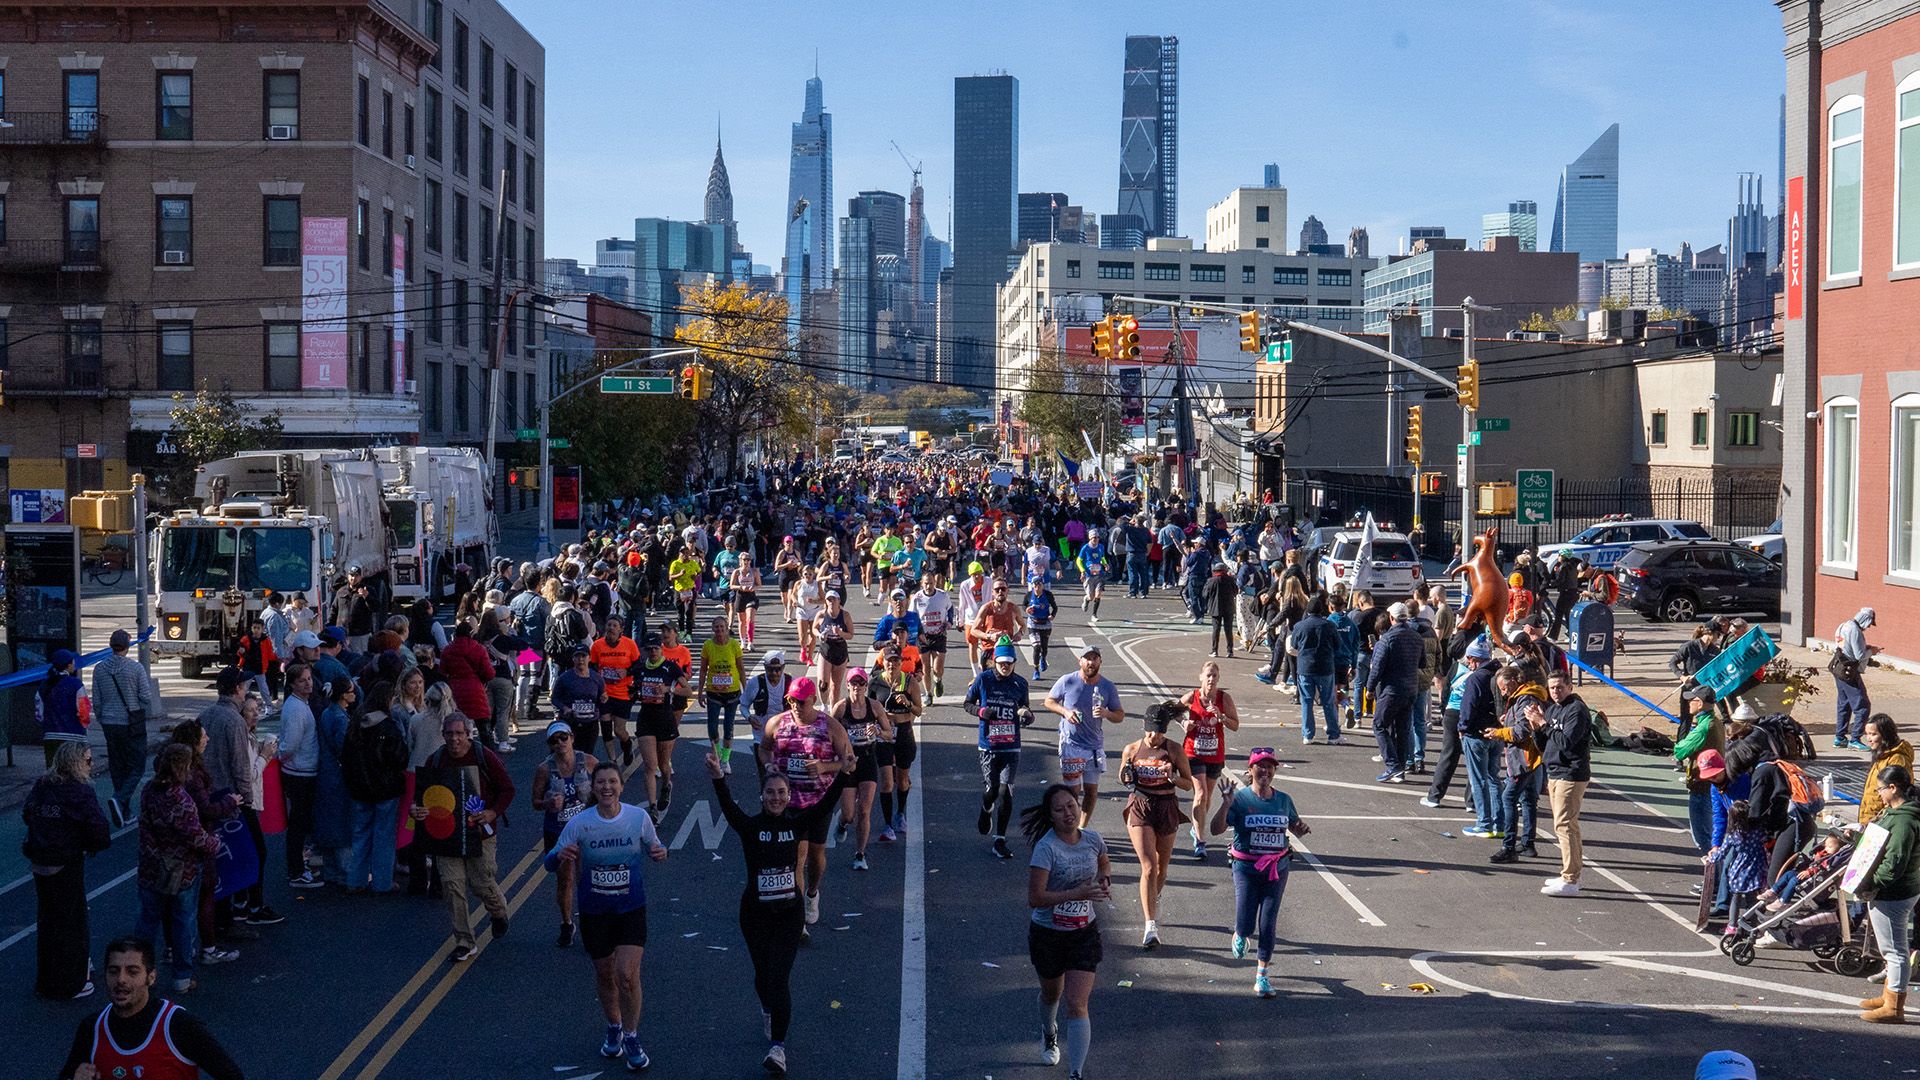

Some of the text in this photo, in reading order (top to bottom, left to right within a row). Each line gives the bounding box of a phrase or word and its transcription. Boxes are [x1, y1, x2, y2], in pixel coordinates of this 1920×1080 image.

[1792, 210, 1800, 286] APEX
[305, 260, 345, 284] 551
[306, 287, 345, 310] 697
[306, 314, 345, 328] 5877
[310, 337, 338, 348] Raw/
[624, 381, 650, 390] 11 St
[1485, 420, 1492, 429] 11
[156, 444, 177, 454] BAR
[790, 759, 806, 768] 345
[759, 830, 794, 842] GO JULI
[1255, 834, 1280, 844] 41401
[590, 838, 633, 849] CAMILA
[594, 872, 628, 882] 43008
[762, 874, 792, 887] 28108
[1058, 902, 1088, 913] 42275
